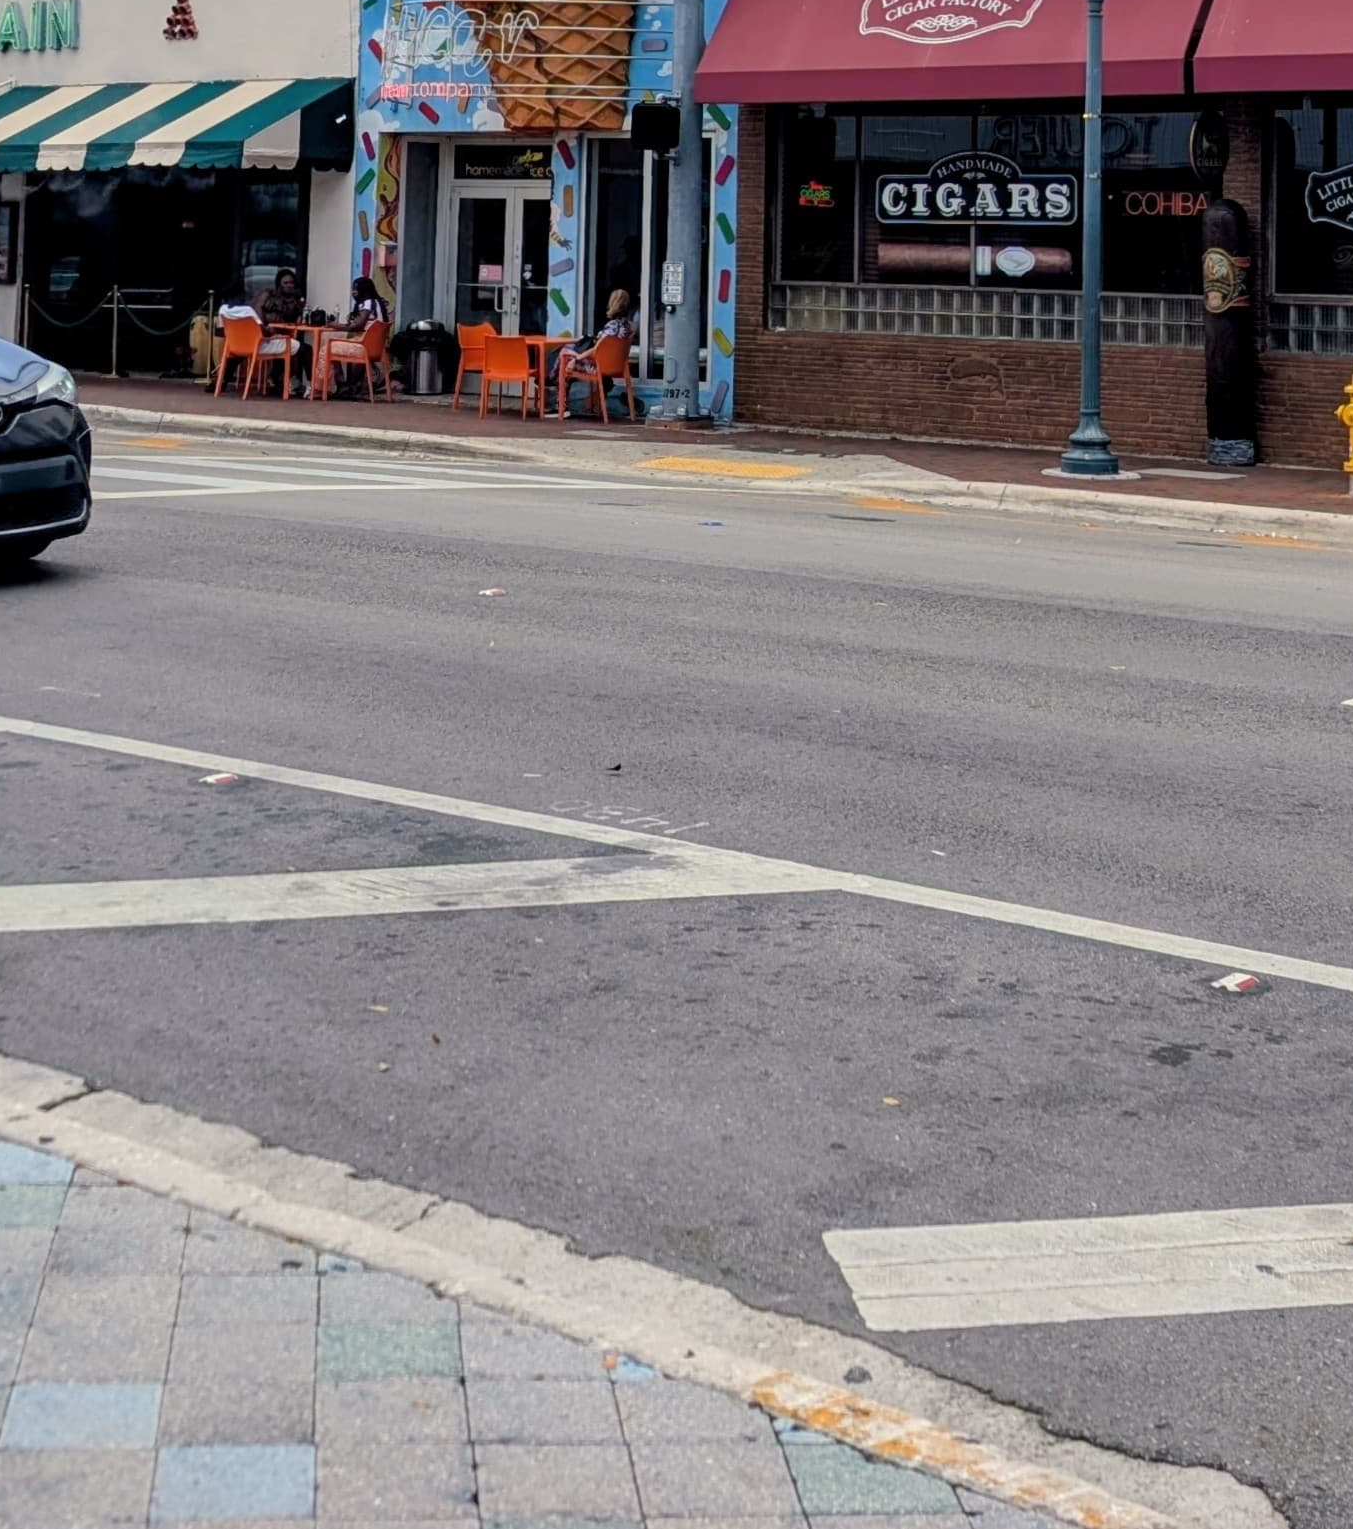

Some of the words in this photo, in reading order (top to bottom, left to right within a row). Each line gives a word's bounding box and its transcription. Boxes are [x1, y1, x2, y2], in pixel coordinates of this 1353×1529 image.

[936, 159, 1013, 179] HANDMADE
[881, 182, 1072, 219] CIGARS
[1125, 191, 1209, 216] COHIBA
